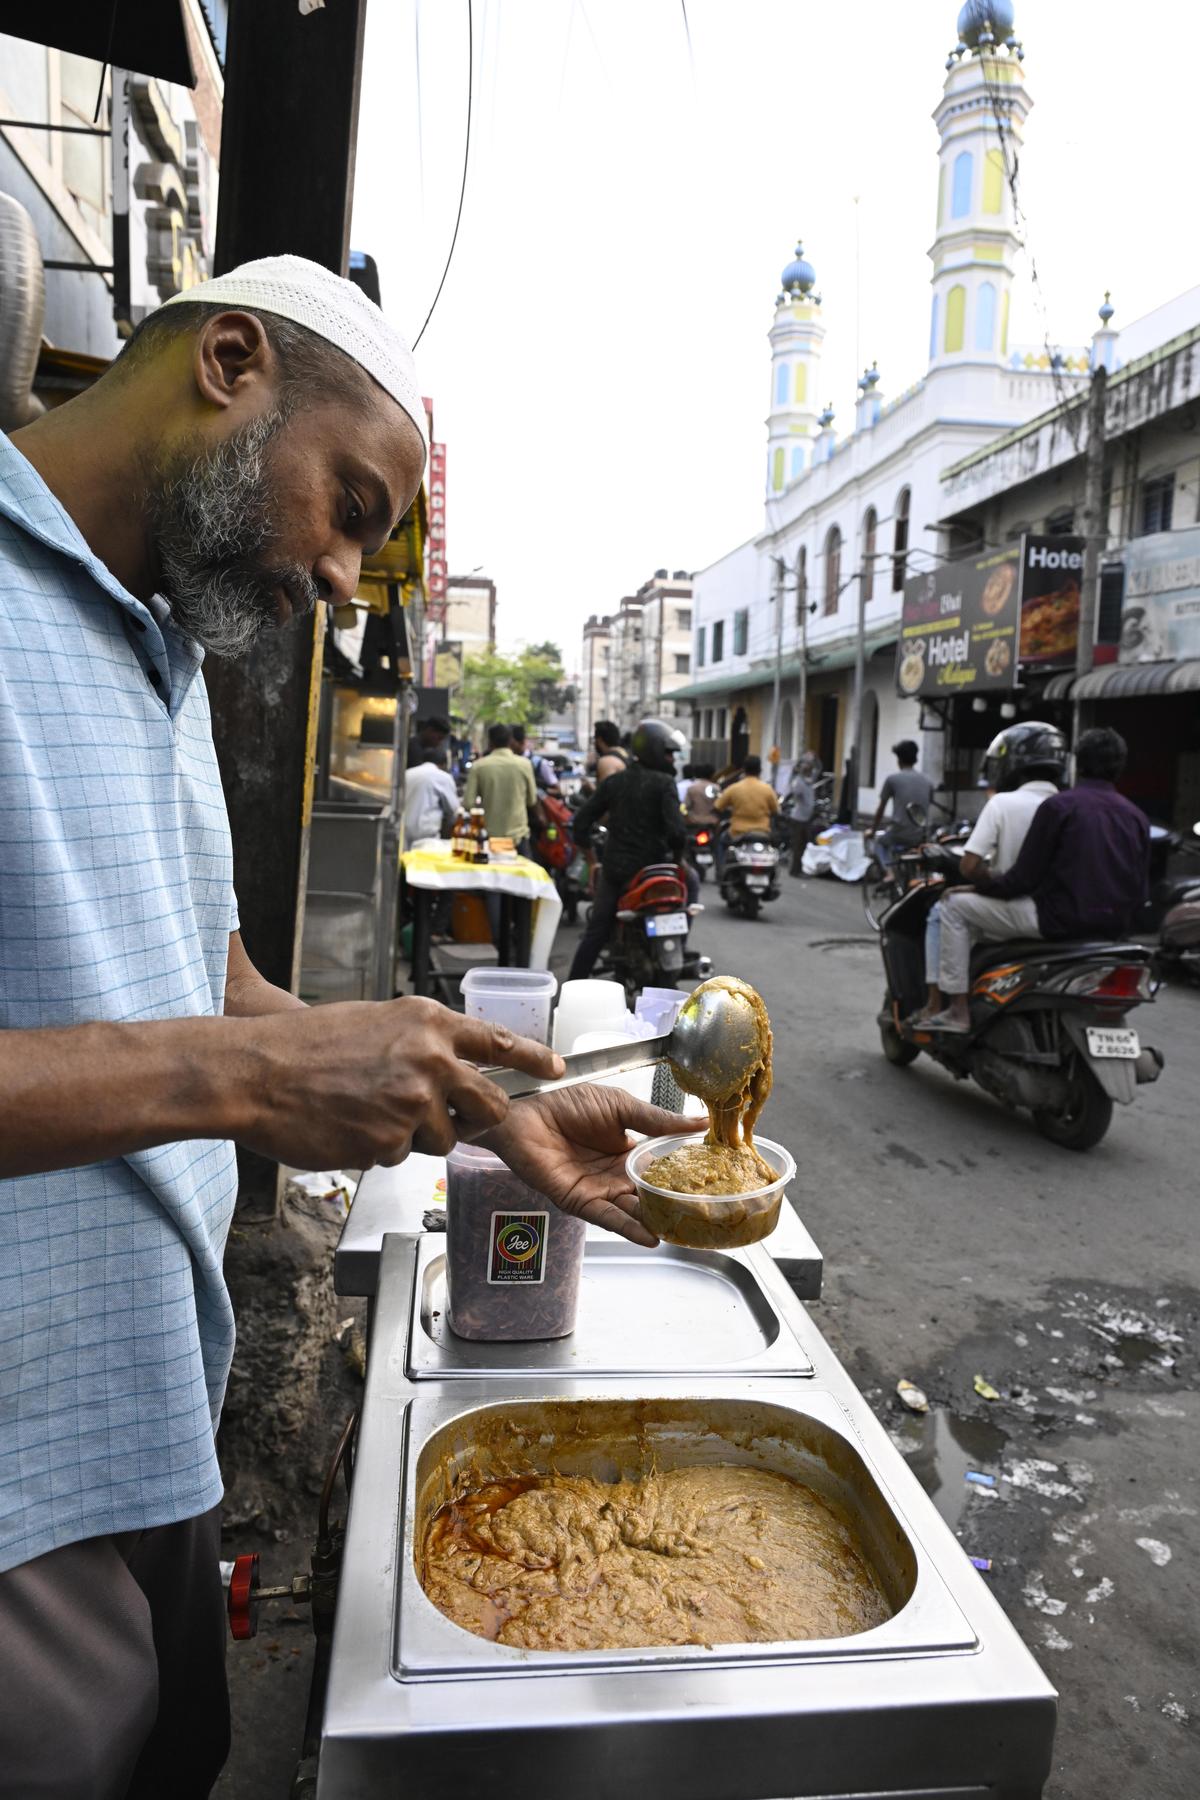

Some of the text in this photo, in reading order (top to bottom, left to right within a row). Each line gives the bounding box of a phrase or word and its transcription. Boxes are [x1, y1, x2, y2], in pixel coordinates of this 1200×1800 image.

[928, 629, 970, 667] Hotel
[1097, 1033, 1114, 1043] TN
[507, 1234, 530, 1250] Jee
